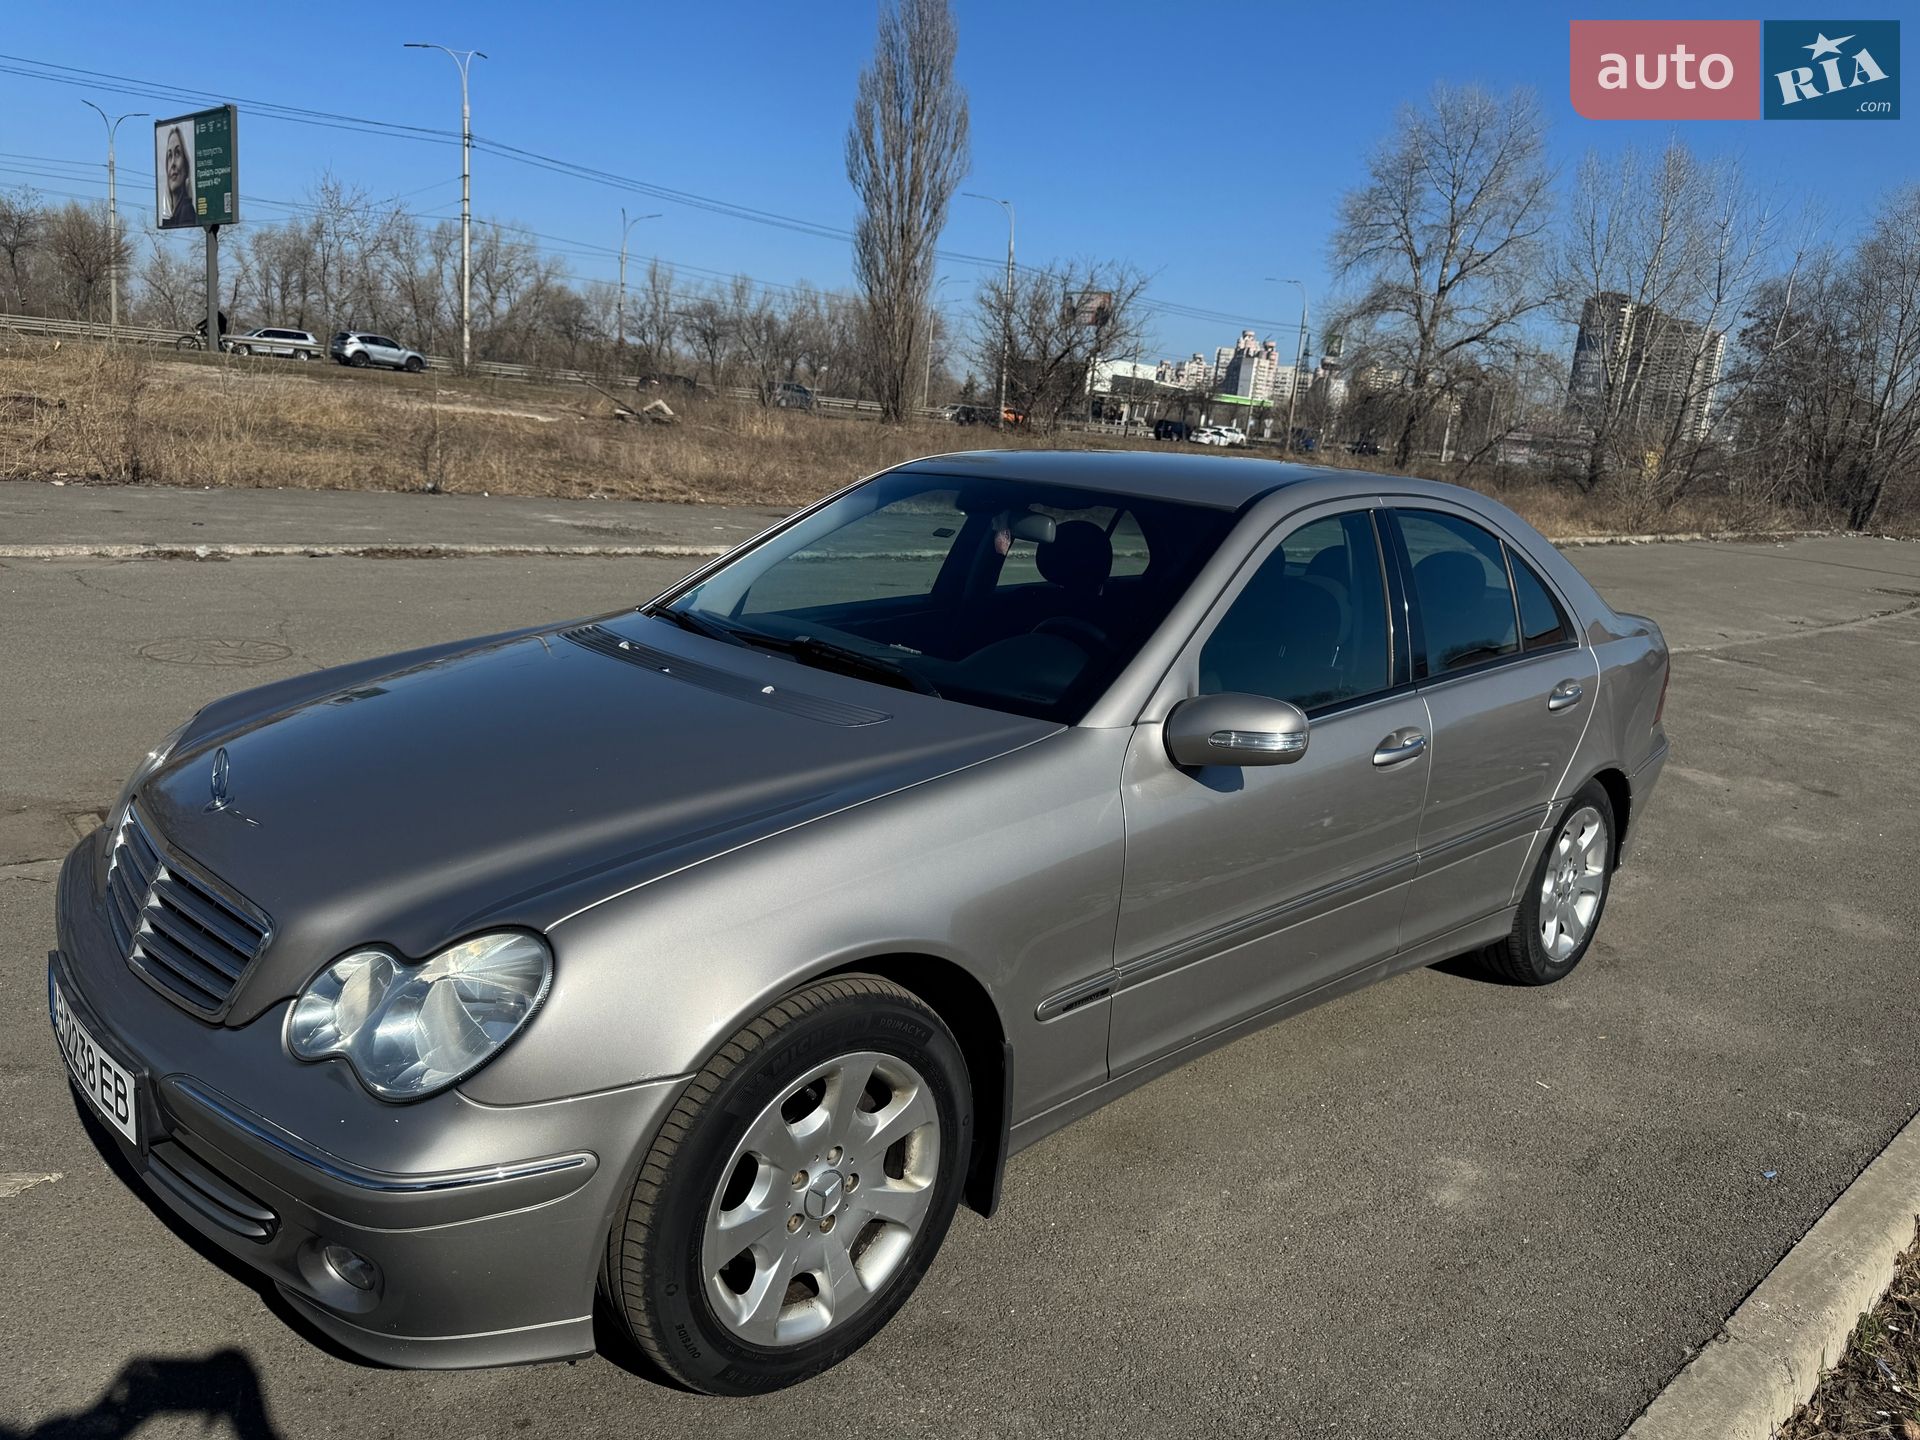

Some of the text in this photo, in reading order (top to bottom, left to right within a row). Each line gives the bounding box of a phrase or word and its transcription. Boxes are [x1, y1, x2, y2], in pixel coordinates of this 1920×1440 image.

[879, 1017, 922, 1036] PRIMACY
[65, 1013, 97, 1093] 2238
[100, 1055, 130, 1126] EB
[675, 1323, 701, 1359] OUTSIDE
